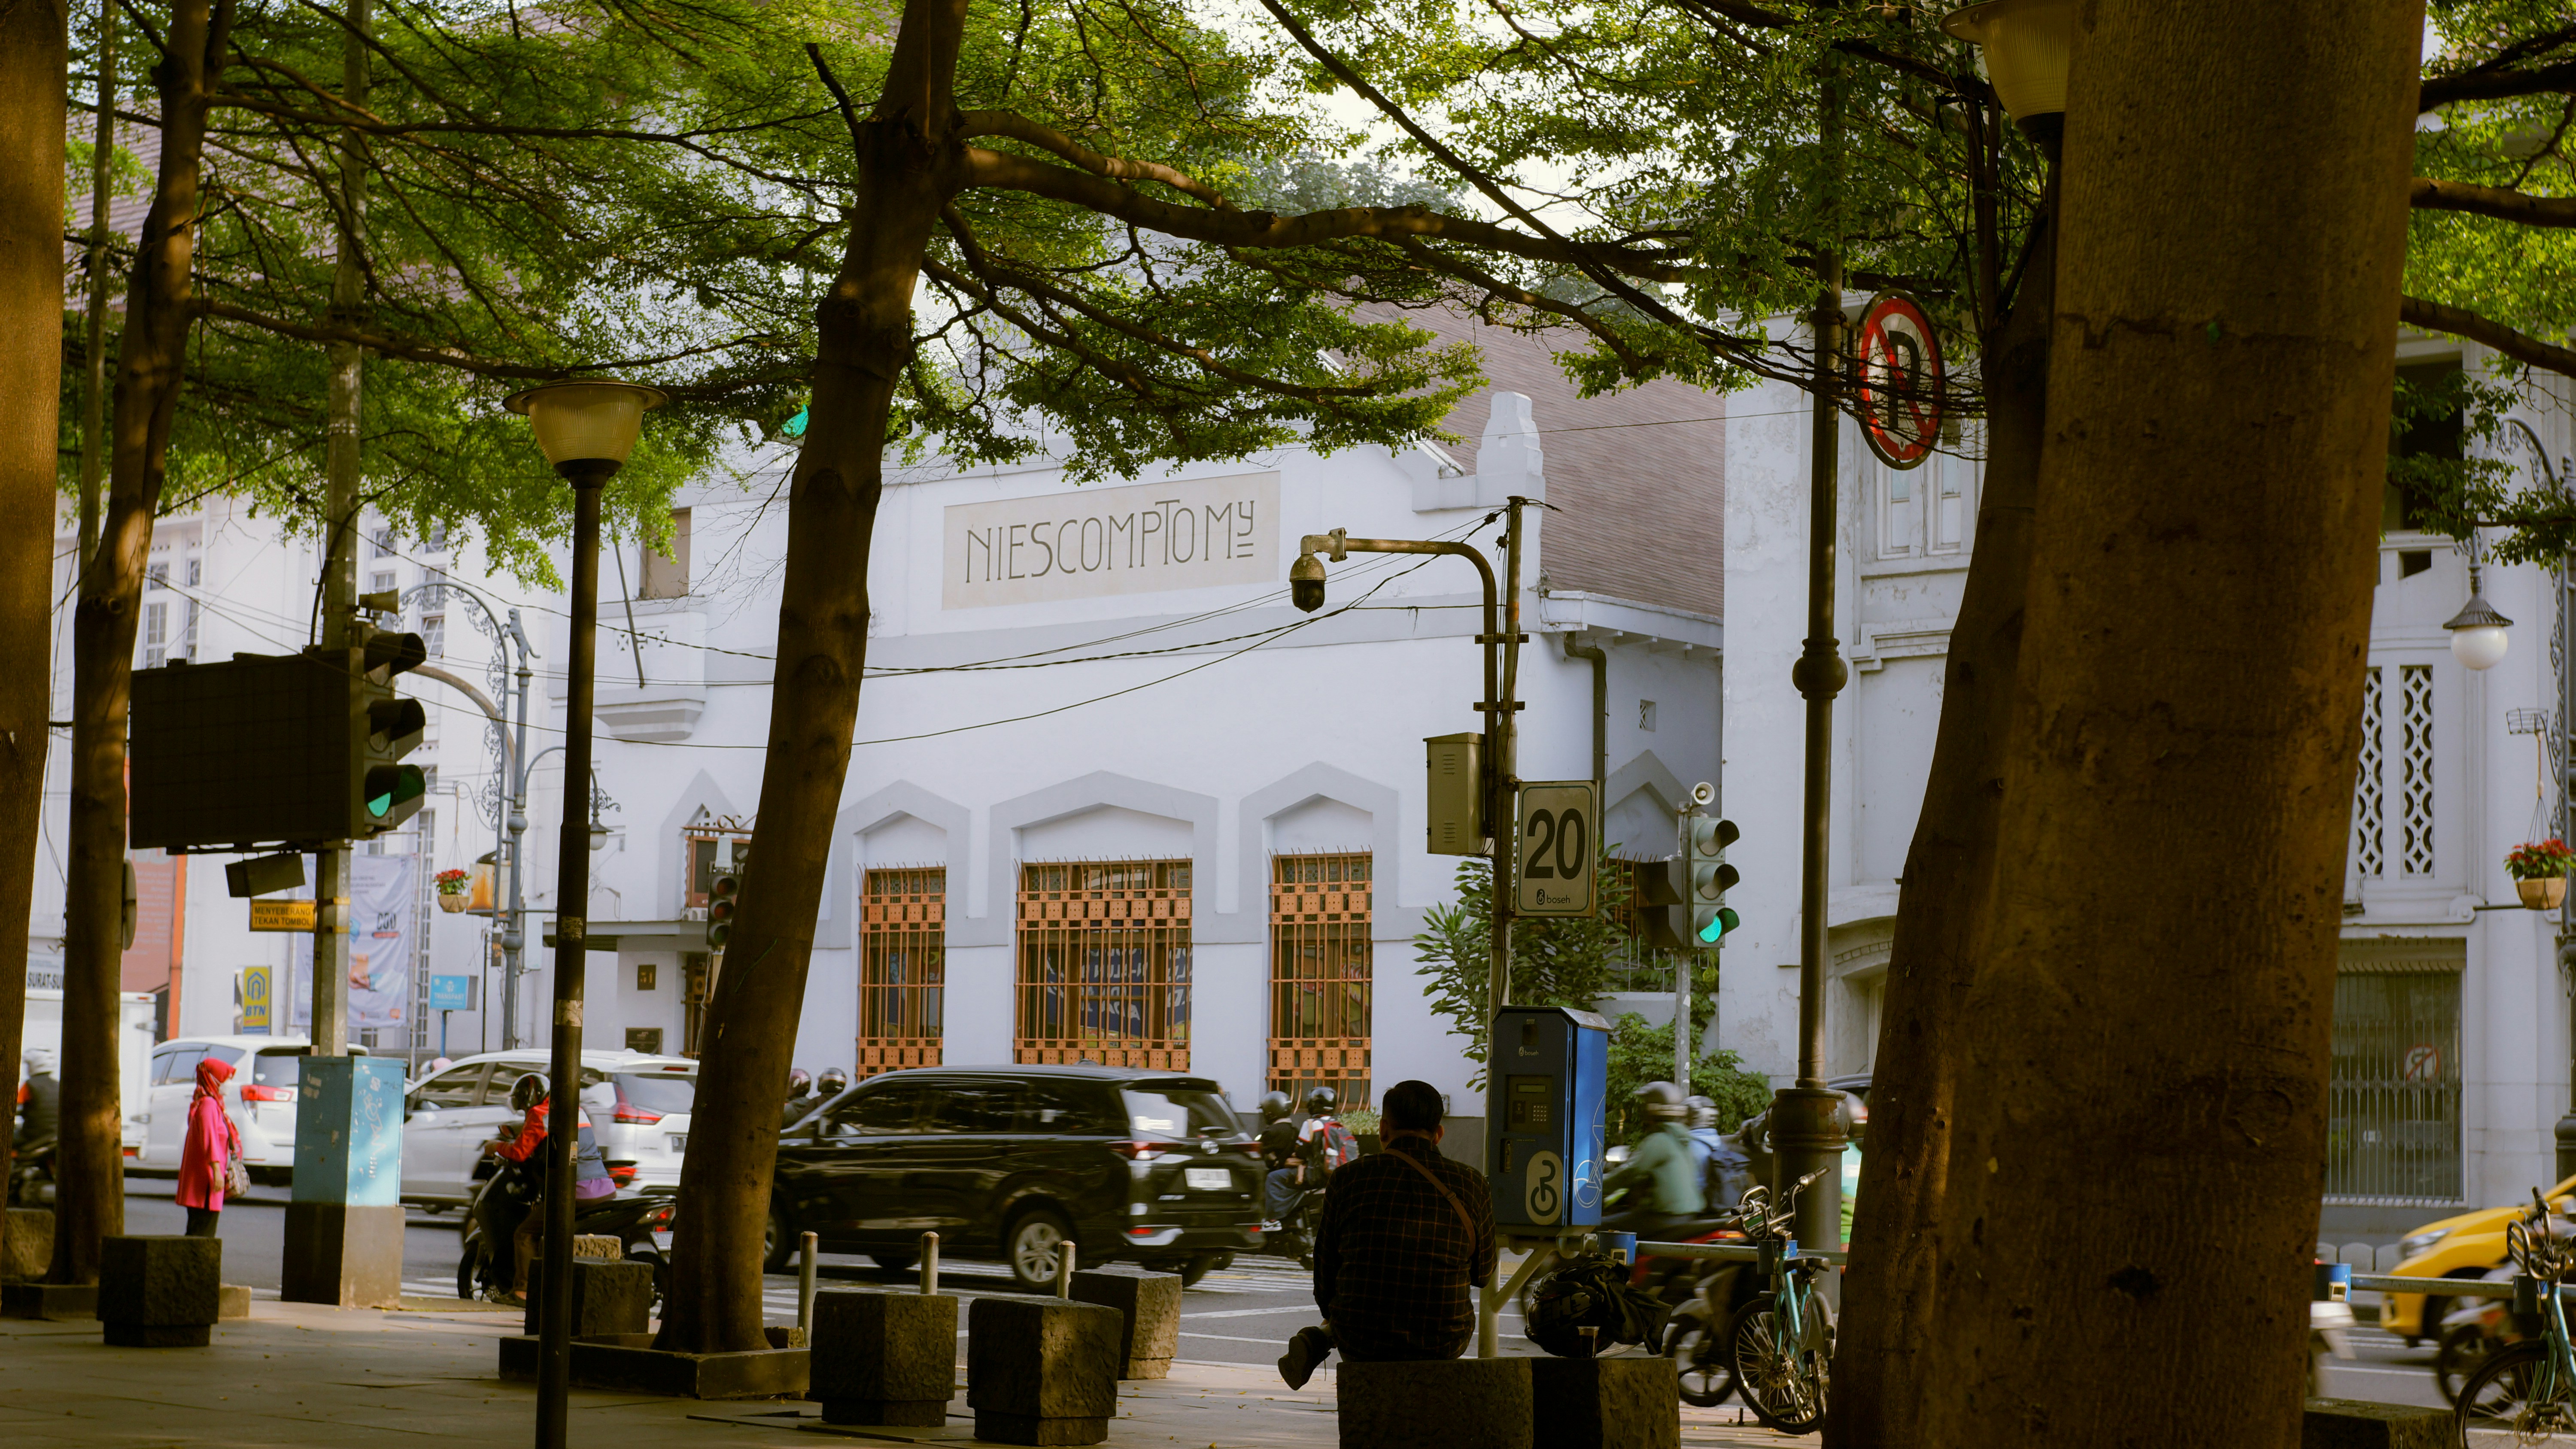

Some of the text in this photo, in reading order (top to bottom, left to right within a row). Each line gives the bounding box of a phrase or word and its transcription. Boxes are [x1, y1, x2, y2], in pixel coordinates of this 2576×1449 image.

[1524, 808, 1586, 880] 20
[1546, 894, 1571, 905] boseh
[255, 906, 311, 915] MENYEBERANG
[254, 916, 312, 926] TEKAN TOMBOL
[245, 1006, 266, 1017] BTN
